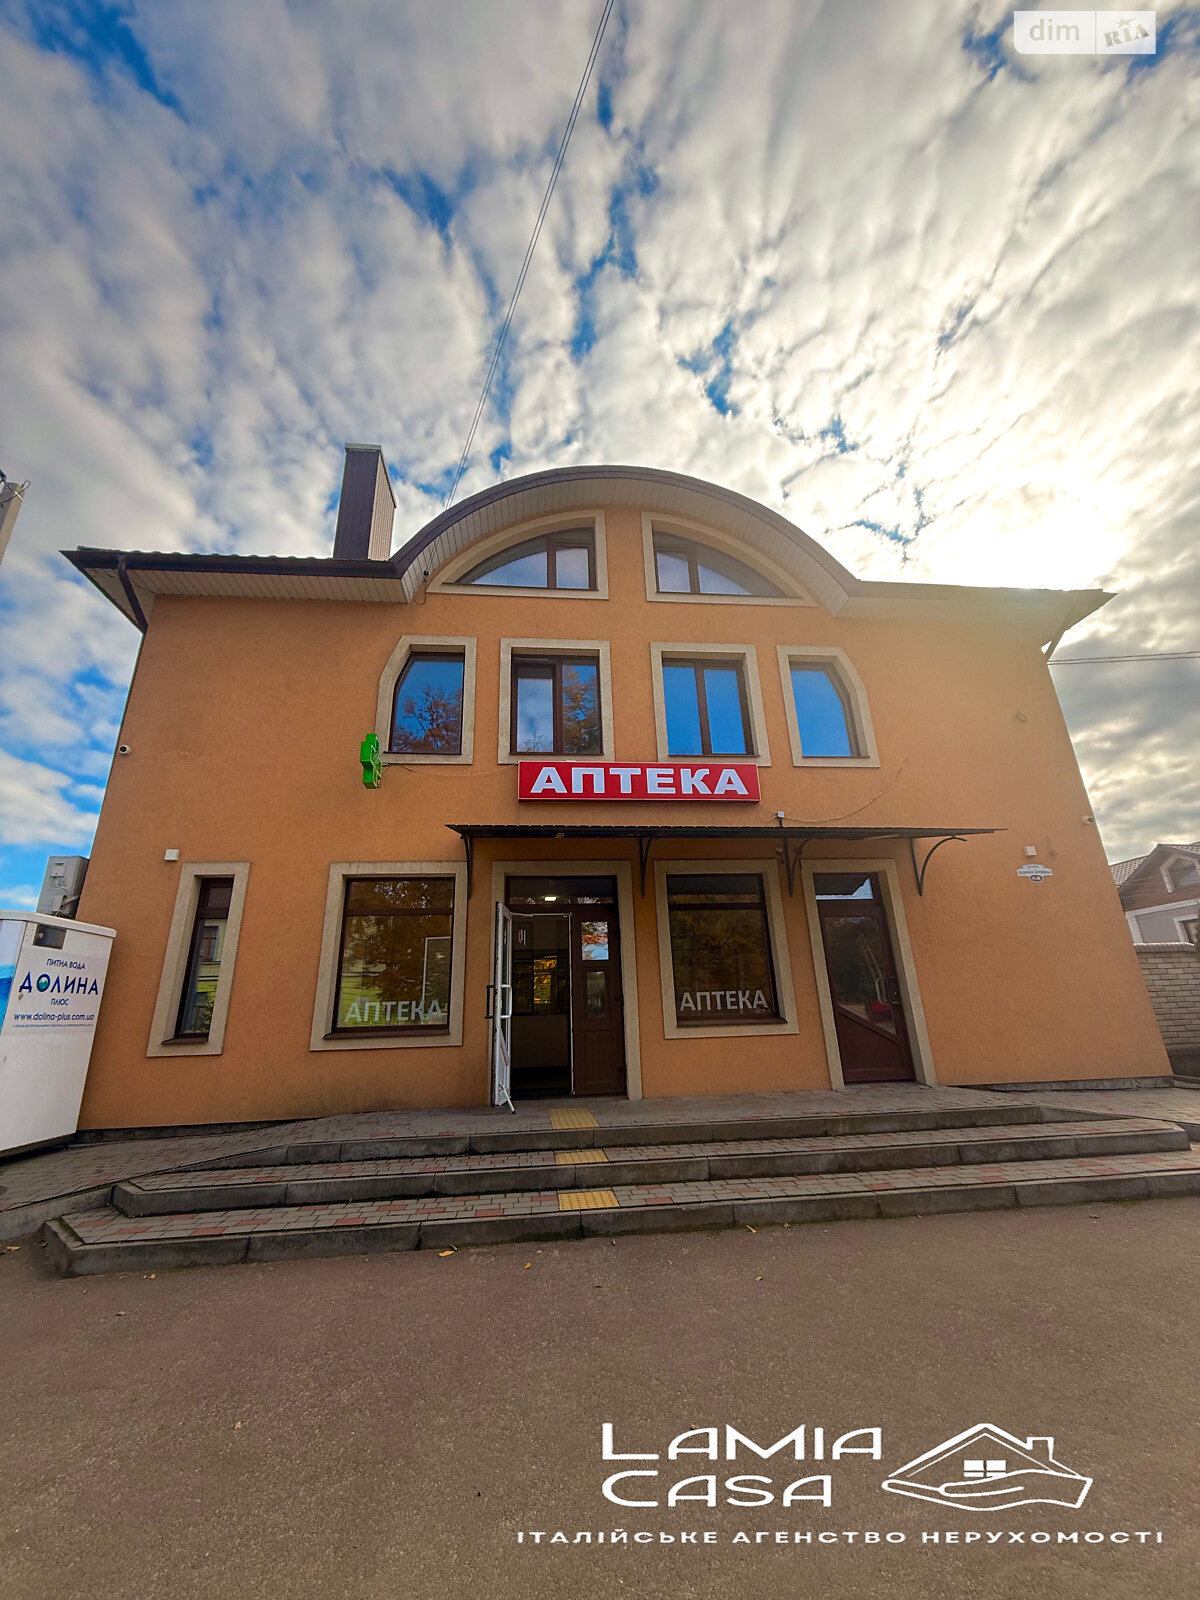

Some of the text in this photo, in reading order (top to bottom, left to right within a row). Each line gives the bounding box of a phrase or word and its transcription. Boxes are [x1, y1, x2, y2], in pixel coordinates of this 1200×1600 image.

[530, 766, 749, 795] АПТЕКА
[46, 958, 86, 970] ПИТНА ВОДА
[18, 970, 98, 994] ДОЛИНА
[343, 999, 443, 1023] АПТЕКА
[680, 989, 769, 1012] АПТЕКА
[14, 1012, 94, 1022] www.dolina-plus.com.ua
